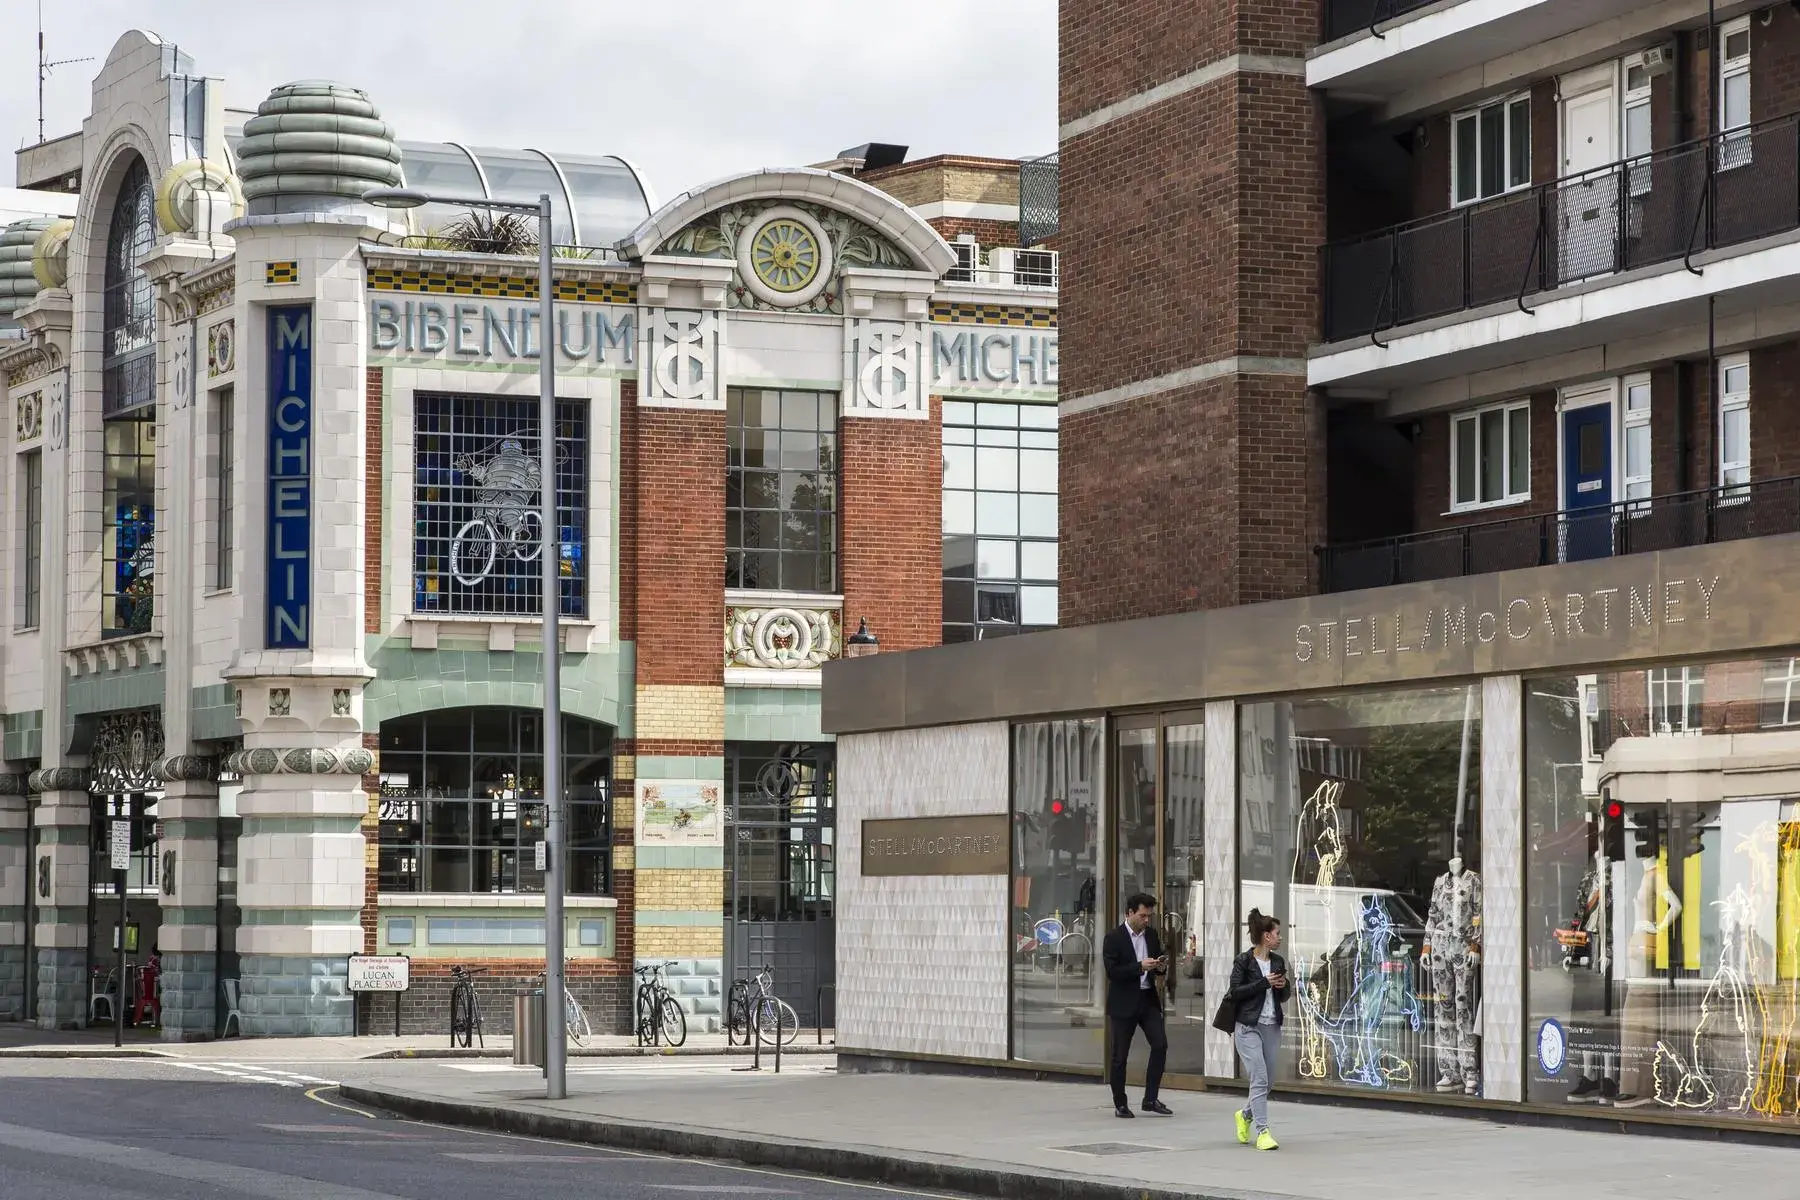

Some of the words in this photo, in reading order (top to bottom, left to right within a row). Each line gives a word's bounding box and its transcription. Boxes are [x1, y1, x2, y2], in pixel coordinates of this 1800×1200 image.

[371, 299, 632, 364] BIBENDUM
[274, 312, 309, 643] MICHELIN
[354, 980, 381, 989] PLACE
[384, 980, 403, 989] SW3
[362, 971, 395, 980] LUCAN
